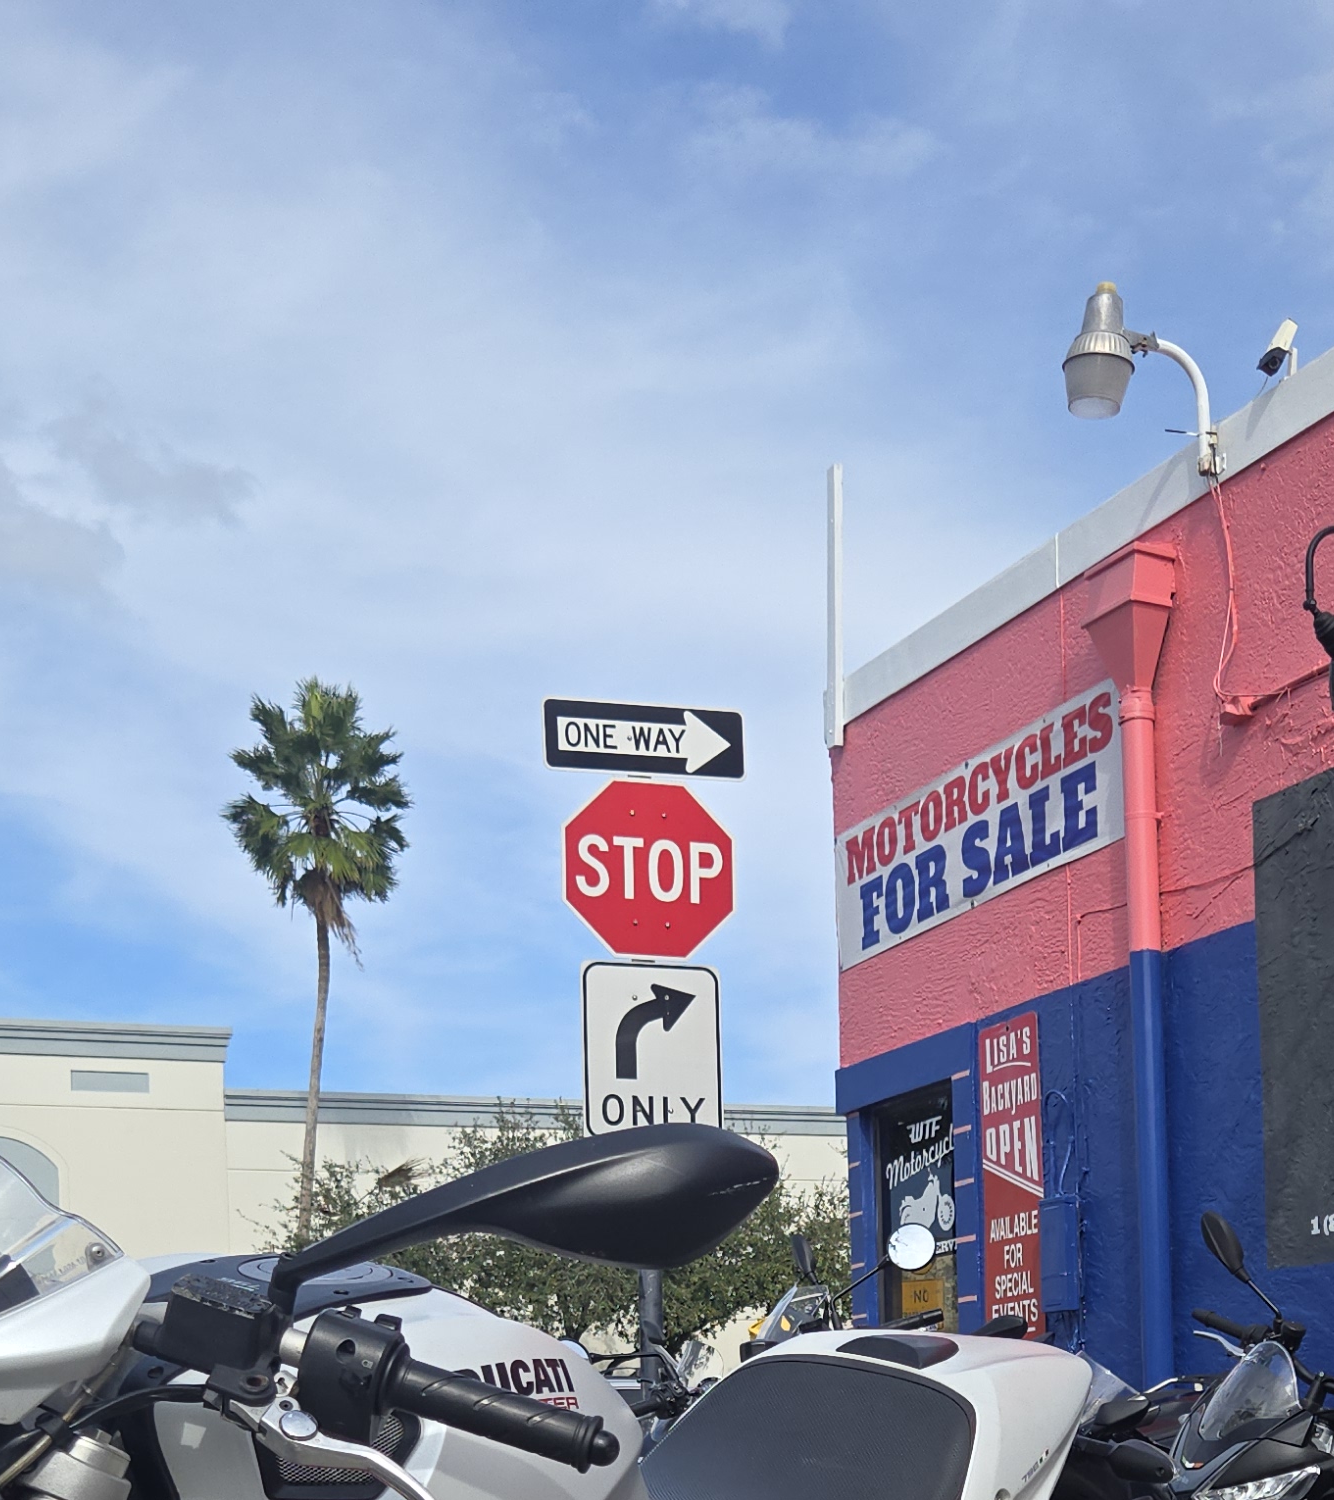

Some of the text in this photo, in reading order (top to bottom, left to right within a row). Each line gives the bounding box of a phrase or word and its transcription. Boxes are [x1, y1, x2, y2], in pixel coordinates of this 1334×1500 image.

[564, 721, 685, 754] ONE WAY
[845, 691, 1113, 886] MOTORCYCLES
[575, 834, 723, 904] STOP
[860, 760, 1098, 951] FOR SALE
[985, 1026, 1031, 1074] LISA'S
[601, 1094, 705, 1126] ONLY
[982, 1072, 1038, 1116] BACKYARD
[906, 1115, 943, 1144] WTF
[985, 1115, 1039, 1181] OPEN
[989, 1210, 1038, 1243] AVAILABLE
[1310, 1215, 1321, 1235] 1
[1003, 1242, 1023, 1269] FOR
[913, 1288, 929, 1304] NO
[994, 1270, 1034, 1299] SPECIAL
